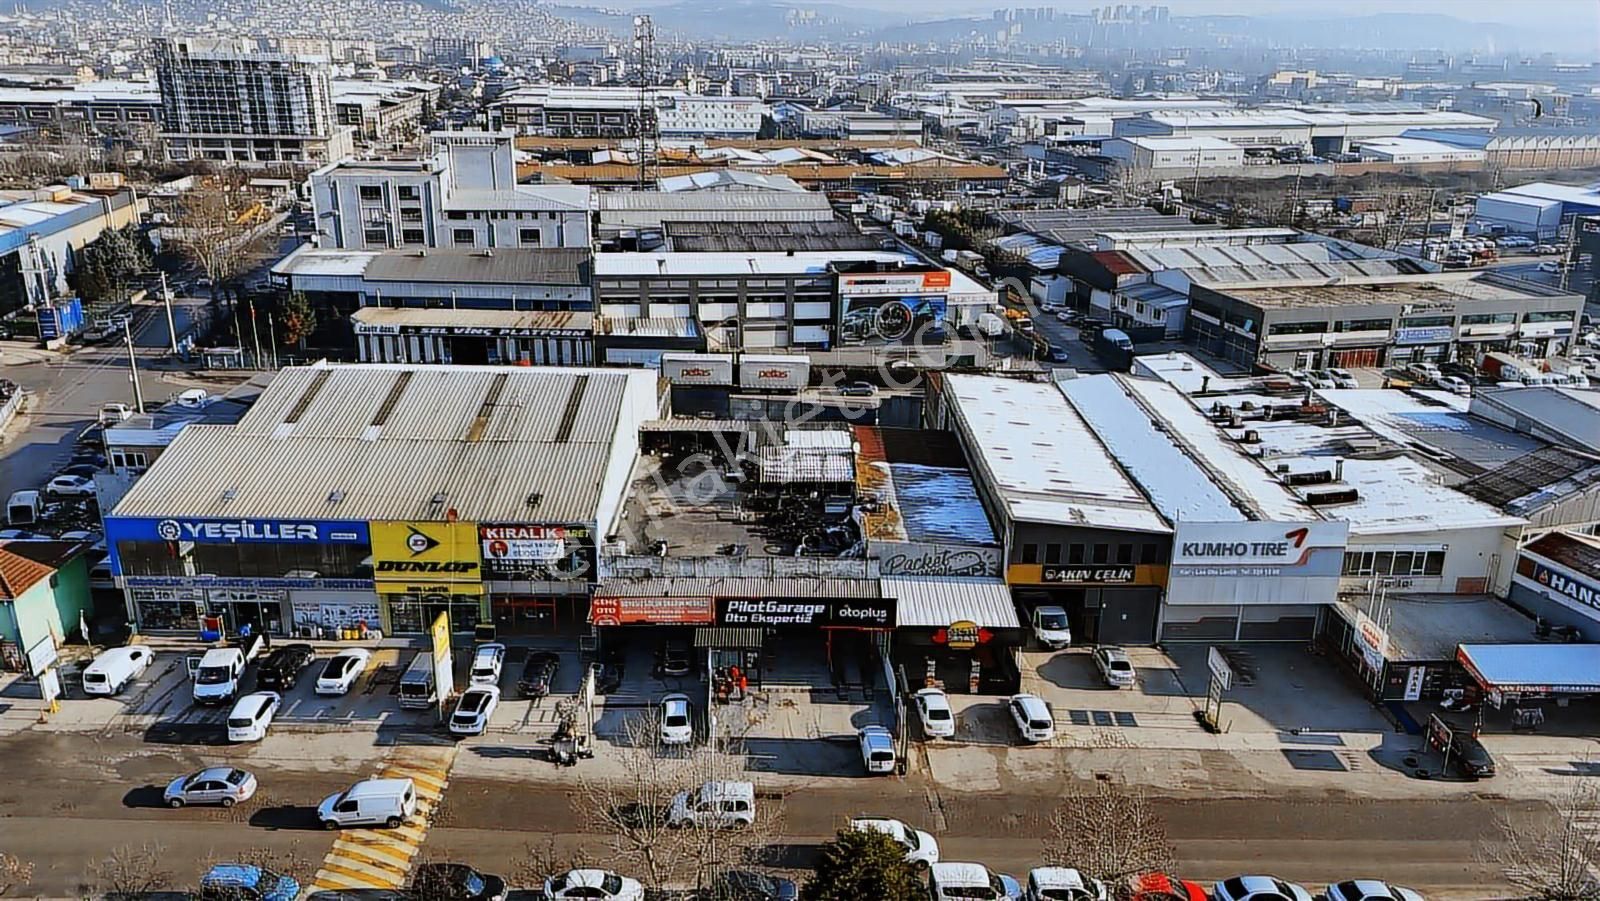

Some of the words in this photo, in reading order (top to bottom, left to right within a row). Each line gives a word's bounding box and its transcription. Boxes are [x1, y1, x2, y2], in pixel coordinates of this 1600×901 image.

[421, 327, 449, 335] SEL
[500, 328, 587, 337] PLATFORM
[182, 519, 319, 543] YEŞİLLER
[486, 526, 561, 540] KİRALIK
[1182, 542, 1248, 557] KUMHO
[1251, 542, 1289, 556] TIRE
[375, 560, 479, 573] DUNLOP
[1056, 569, 1092, 580] AKIN
[596, 607, 616, 615] OTO
[727, 600, 826, 616] PilotGarage
[839, 604, 888, 618] otoplus
[724, 613, 748, 623] Oto
[751, 612, 813, 625] Ekspertiz
